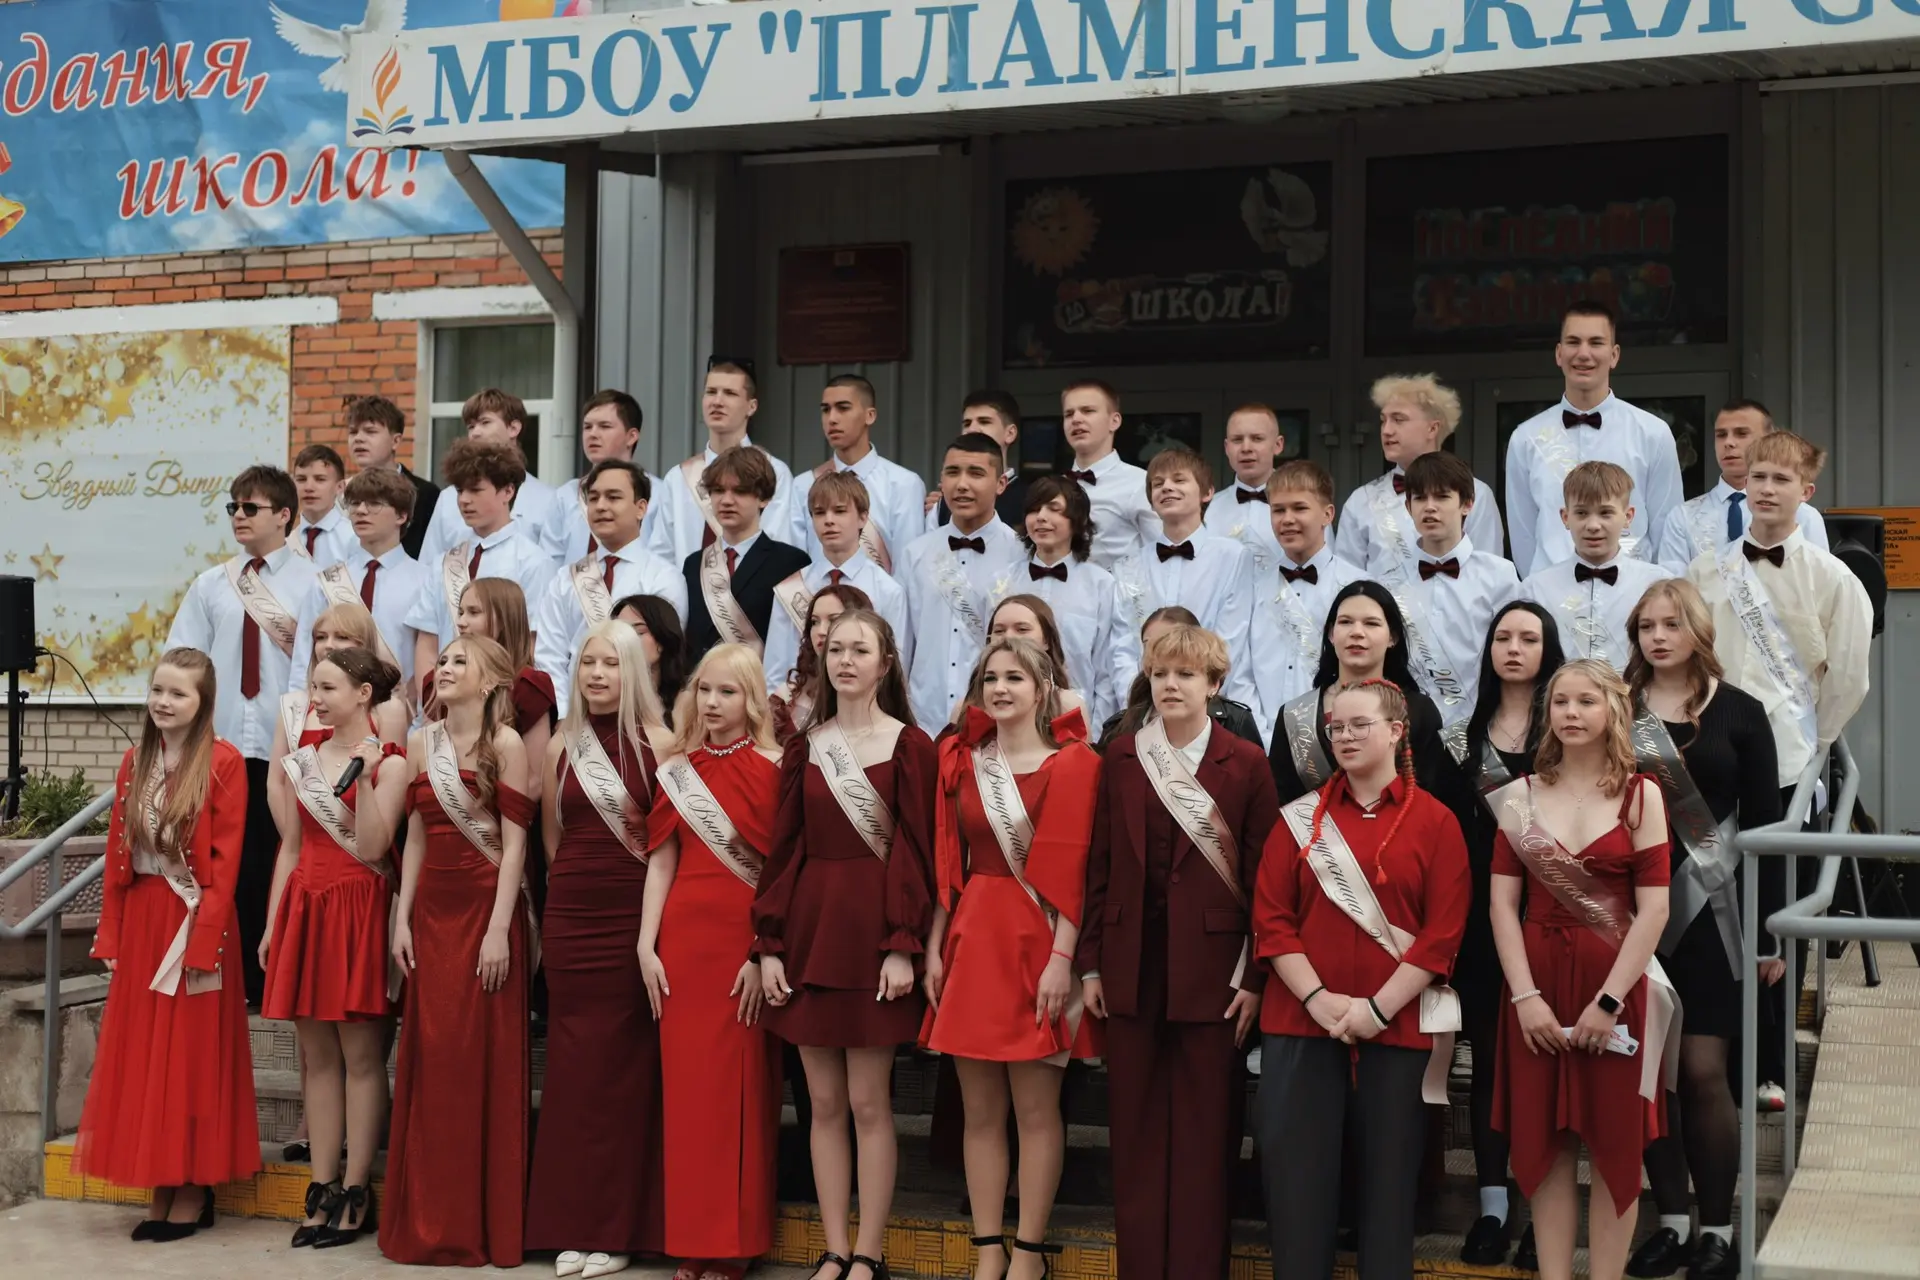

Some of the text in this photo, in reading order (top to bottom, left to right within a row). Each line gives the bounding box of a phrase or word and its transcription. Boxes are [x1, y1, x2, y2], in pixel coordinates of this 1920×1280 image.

[0, 33, 269, 116] дания,
[424, 23, 731, 126] МБОУ
[117, 146, 420, 219] школа!
[20, 460, 137, 510] Звездный
[1427, 668, 1467, 705] 2026
[434, 755, 501, 852] Выпускница
